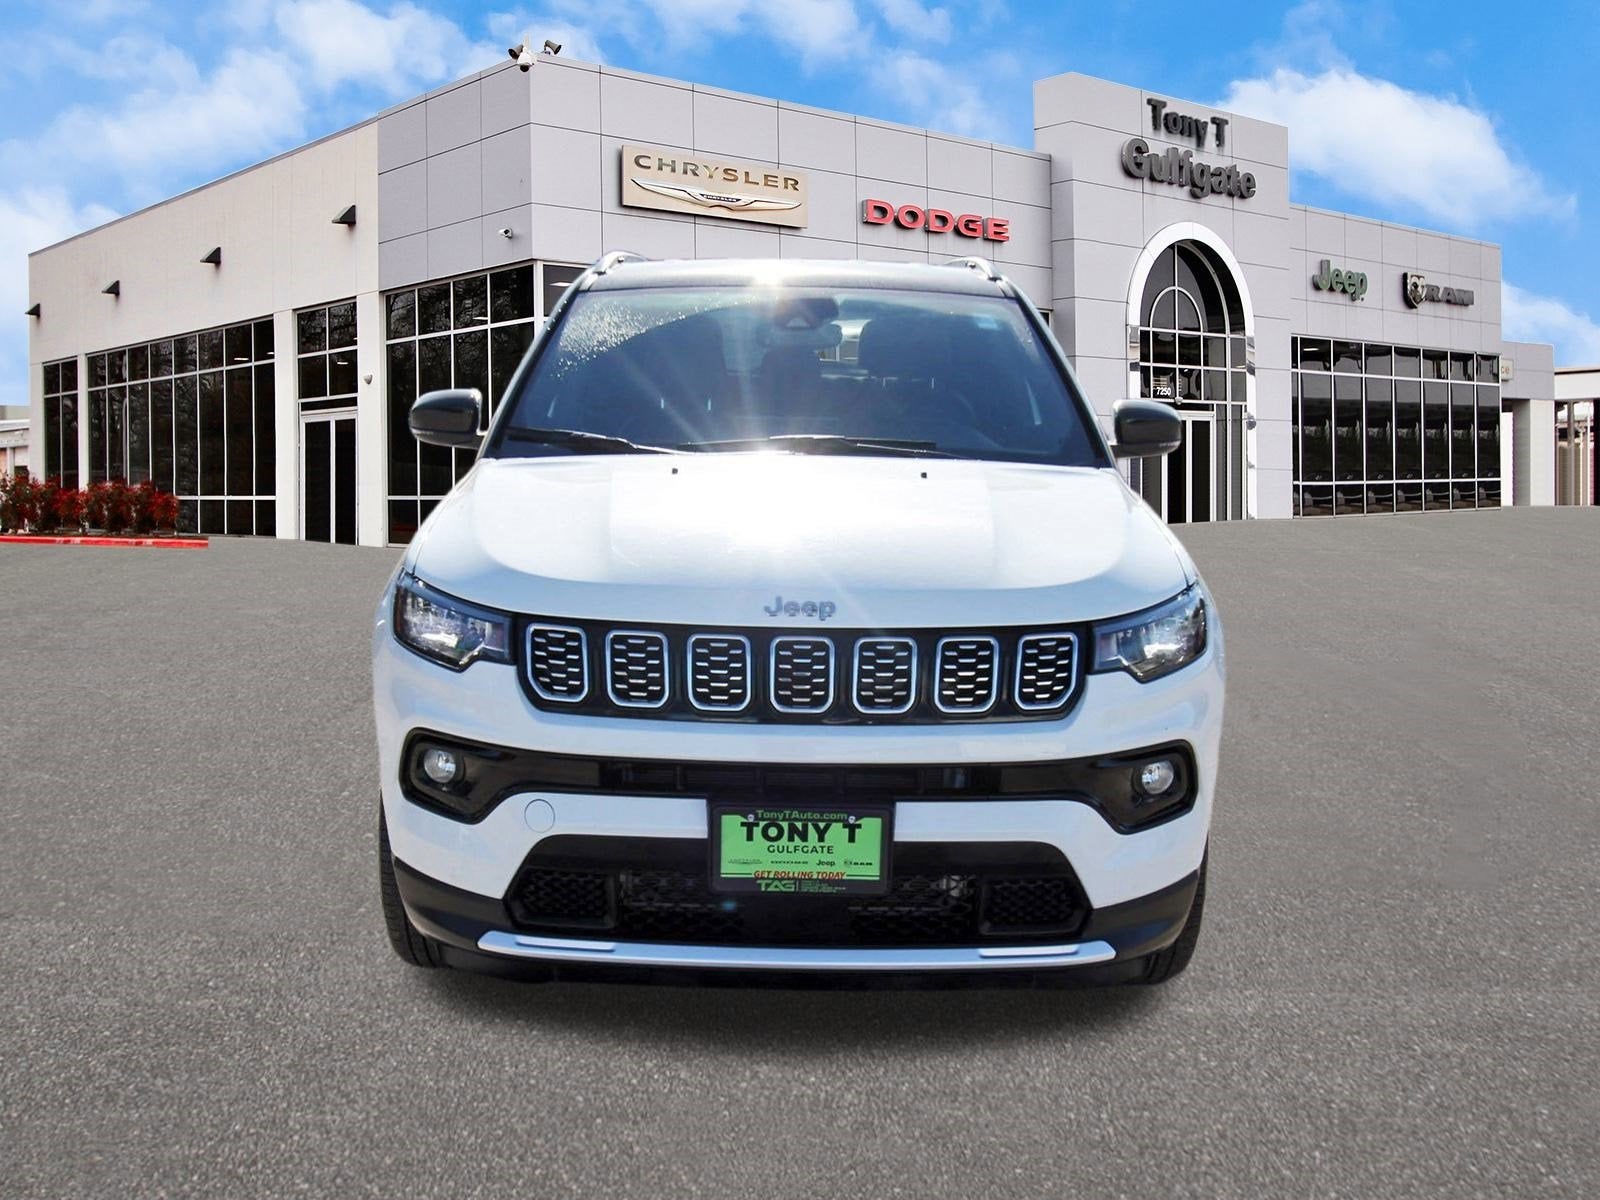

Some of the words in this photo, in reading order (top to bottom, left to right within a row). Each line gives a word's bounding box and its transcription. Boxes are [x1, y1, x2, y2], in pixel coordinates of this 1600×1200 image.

[1146, 98, 1208, 147] Tony
[1210, 116, 1229, 147] T
[633, 154, 800, 191] CHRYSLER
[1121, 137, 1256, 199] Gulfgate
[862, 198, 1010, 242] DODGE
[1312, 259, 1368, 301] Jeep
[1425, 284, 1474, 306] RAM
[1156, 387, 1172, 396] 7250
[763, 596, 836, 621] Jeep
[756, 809, 848, 820] TonyTAuto.com
[740, 821, 830, 843] TONY
[842, 822, 862, 843] T
[767, 844, 834, 854] GULFGATE
[816, 859, 836, 867] Jeep
[754, 870, 770, 879] GET
[774, 871, 813, 879] ROLLING
[816, 871, 847, 880] TODAY
[756, 879, 795, 892] TAG
